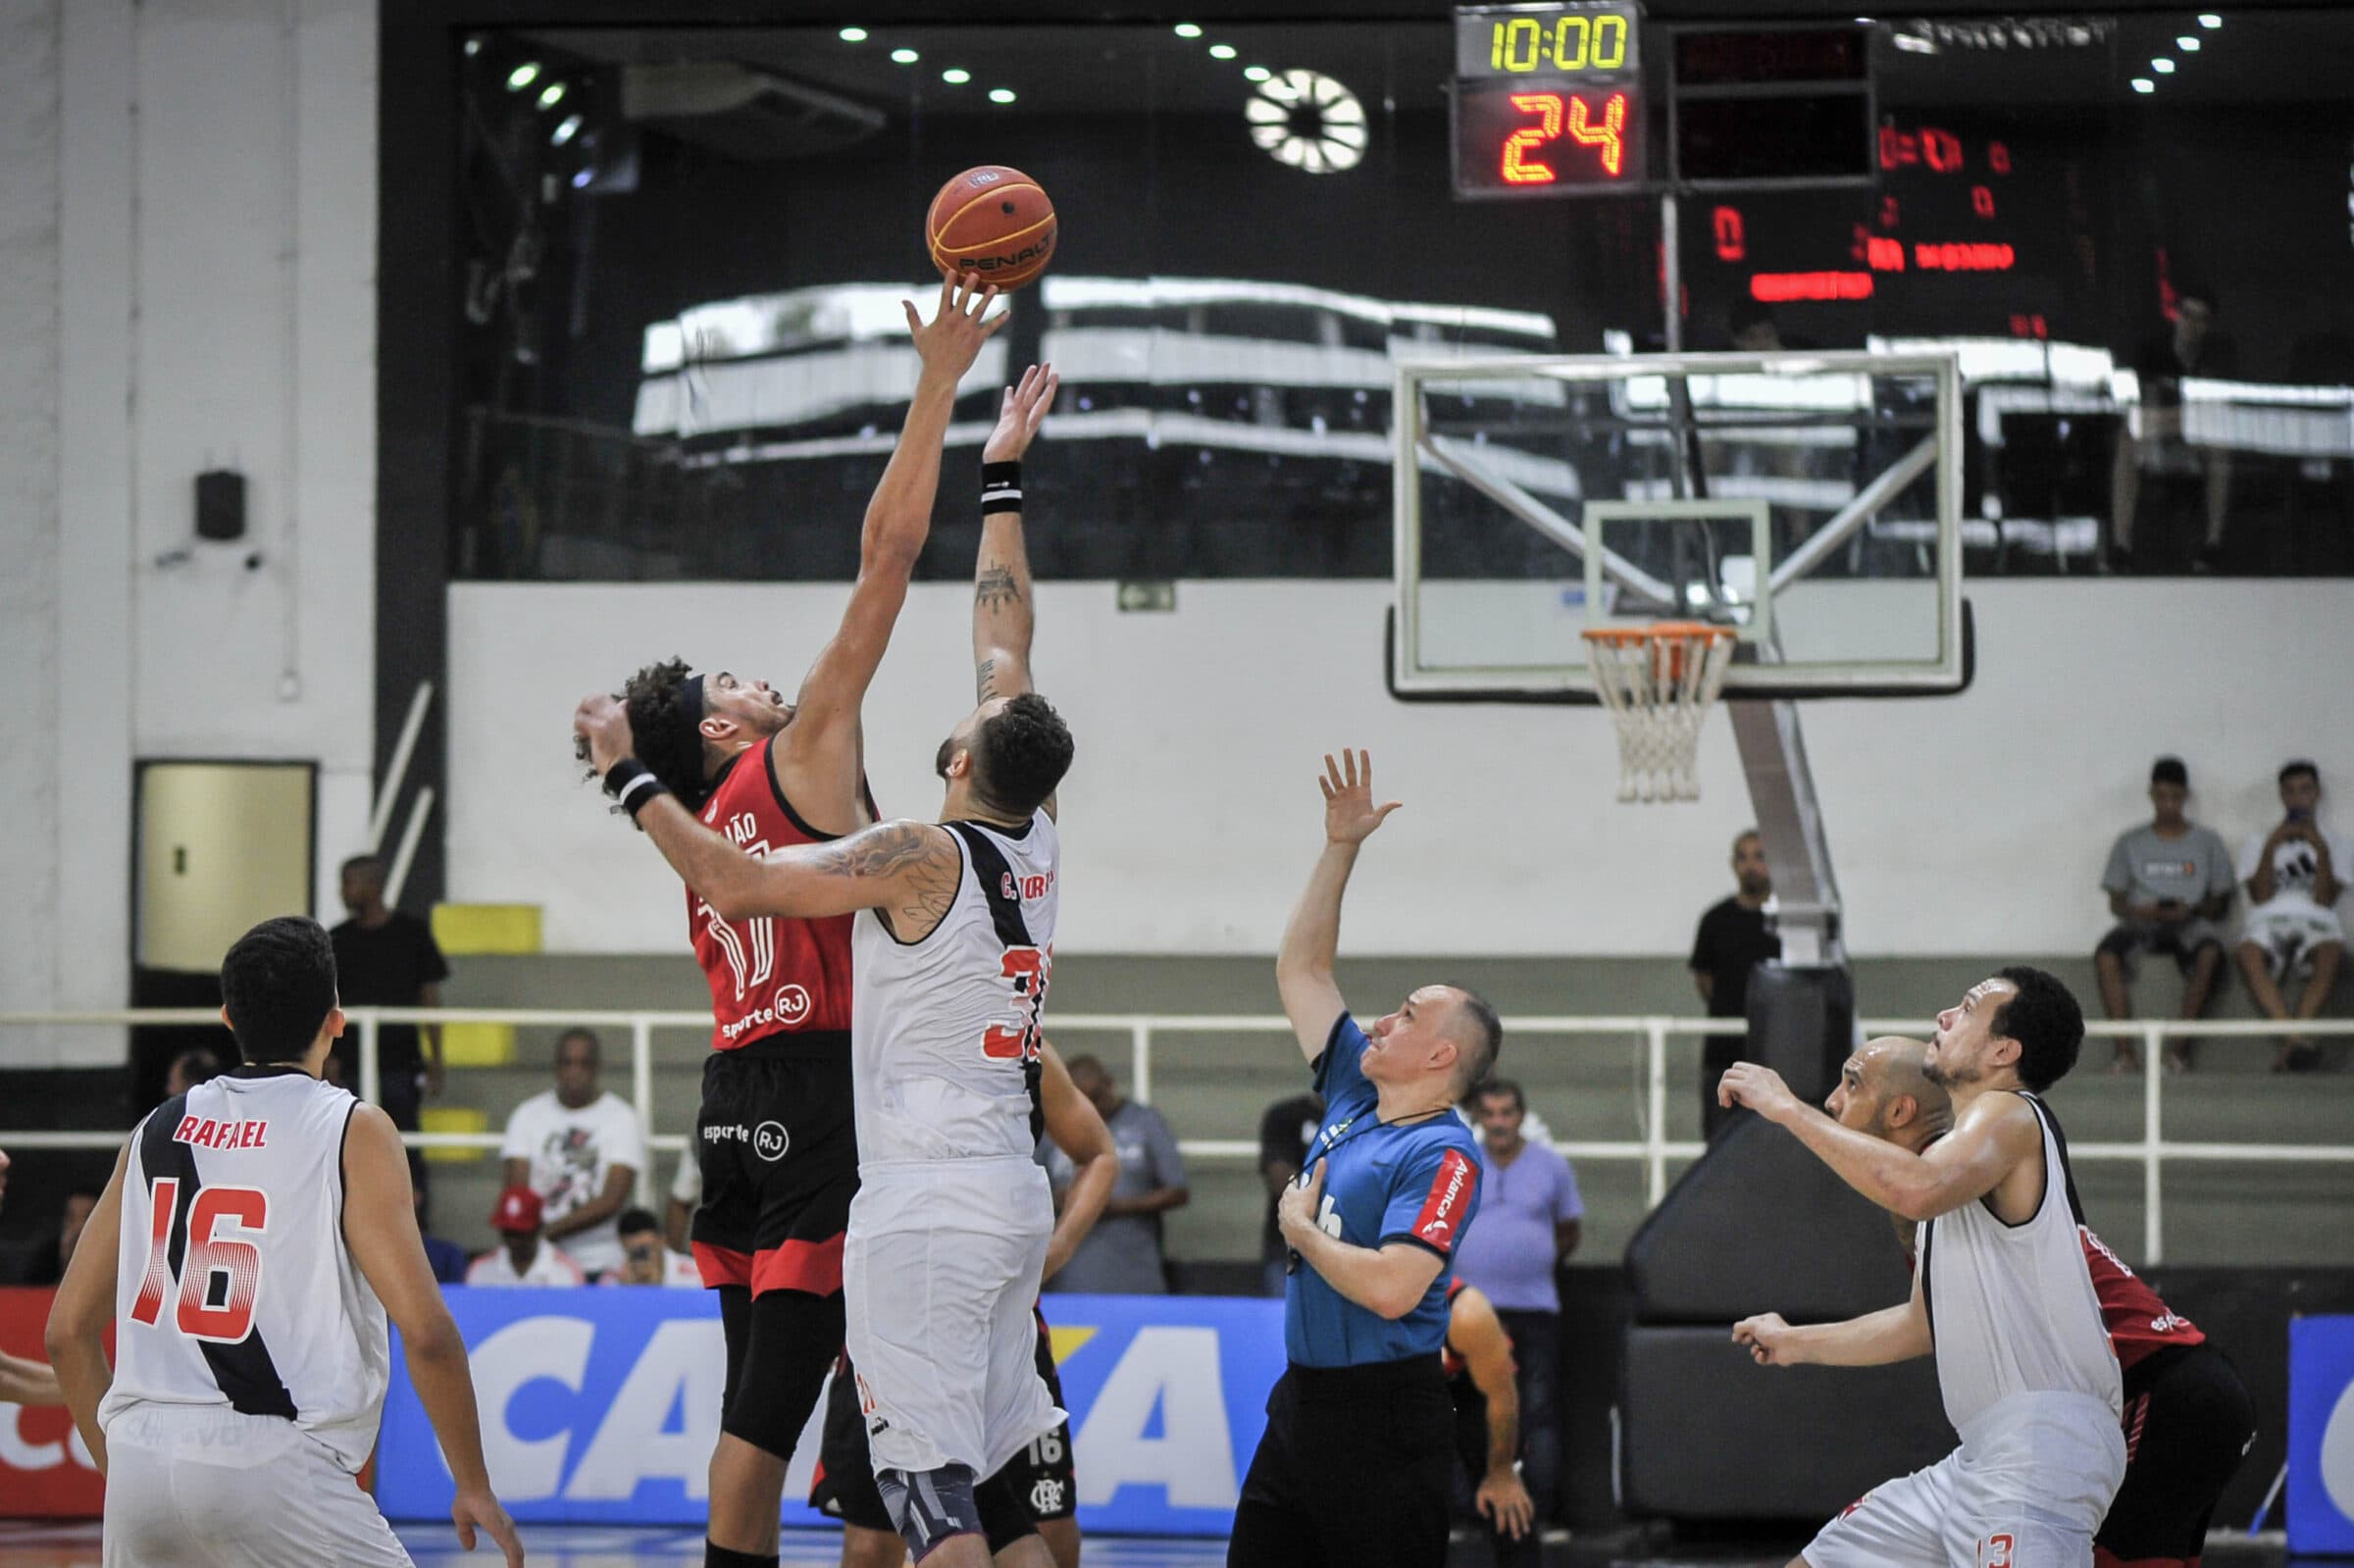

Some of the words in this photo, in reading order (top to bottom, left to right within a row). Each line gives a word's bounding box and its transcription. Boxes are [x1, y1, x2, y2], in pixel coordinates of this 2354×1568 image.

[1491, 15, 1627, 72] 10:00
[1503, 94, 1625, 184] 24
[959, 228, 1053, 271] PENALT
[779, 994, 803, 1014] RJ
[984, 943, 1053, 1059] 3
[173, 1115, 269, 1151] RAFAEL
[759, 1131, 783, 1150] RJ
[1437, 1158, 1468, 1218] Avianca
[126, 1178, 270, 1344] 16
[1029, 1429, 1063, 1466] 16
